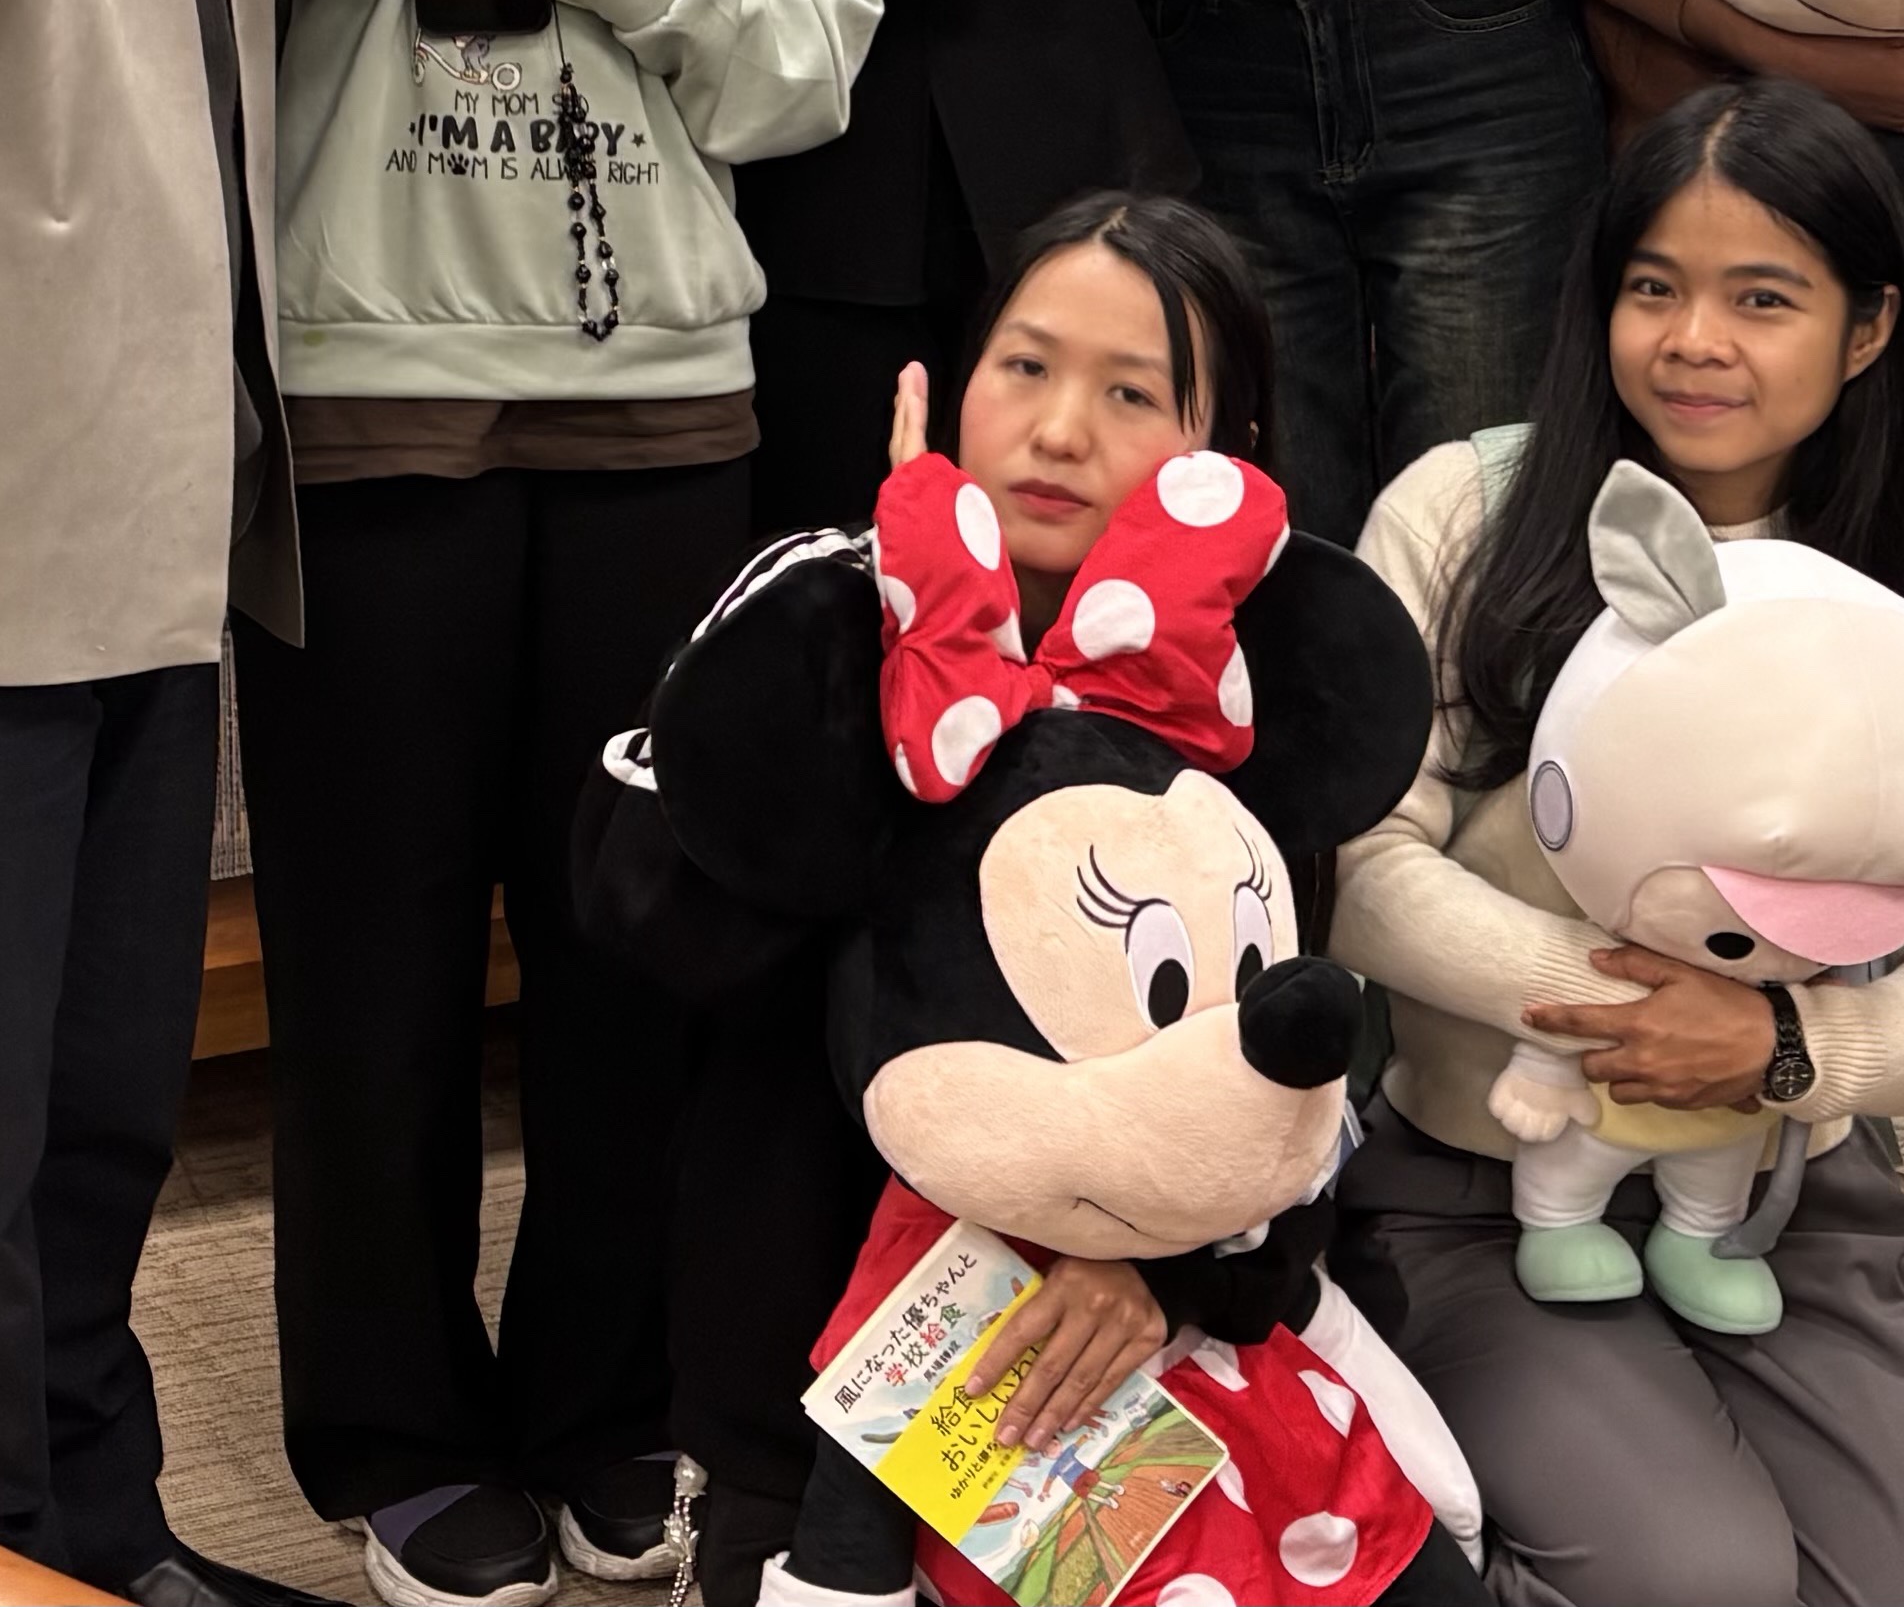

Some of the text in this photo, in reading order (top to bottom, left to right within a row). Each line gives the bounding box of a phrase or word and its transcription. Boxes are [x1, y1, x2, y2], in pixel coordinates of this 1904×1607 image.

[453, 89, 480, 115] MY
[491, 91, 540, 118] MOM
[417, 112, 479, 151] I'M
[489, 119, 517, 153] A
[385, 148, 418, 174] AND
[500, 156, 519, 180] IS
[607, 161, 660, 185] RIGHT
[833, 1251, 978, 1414] 風になった優ちゃんと
[883, 1300, 969, 1388] 学校給食
